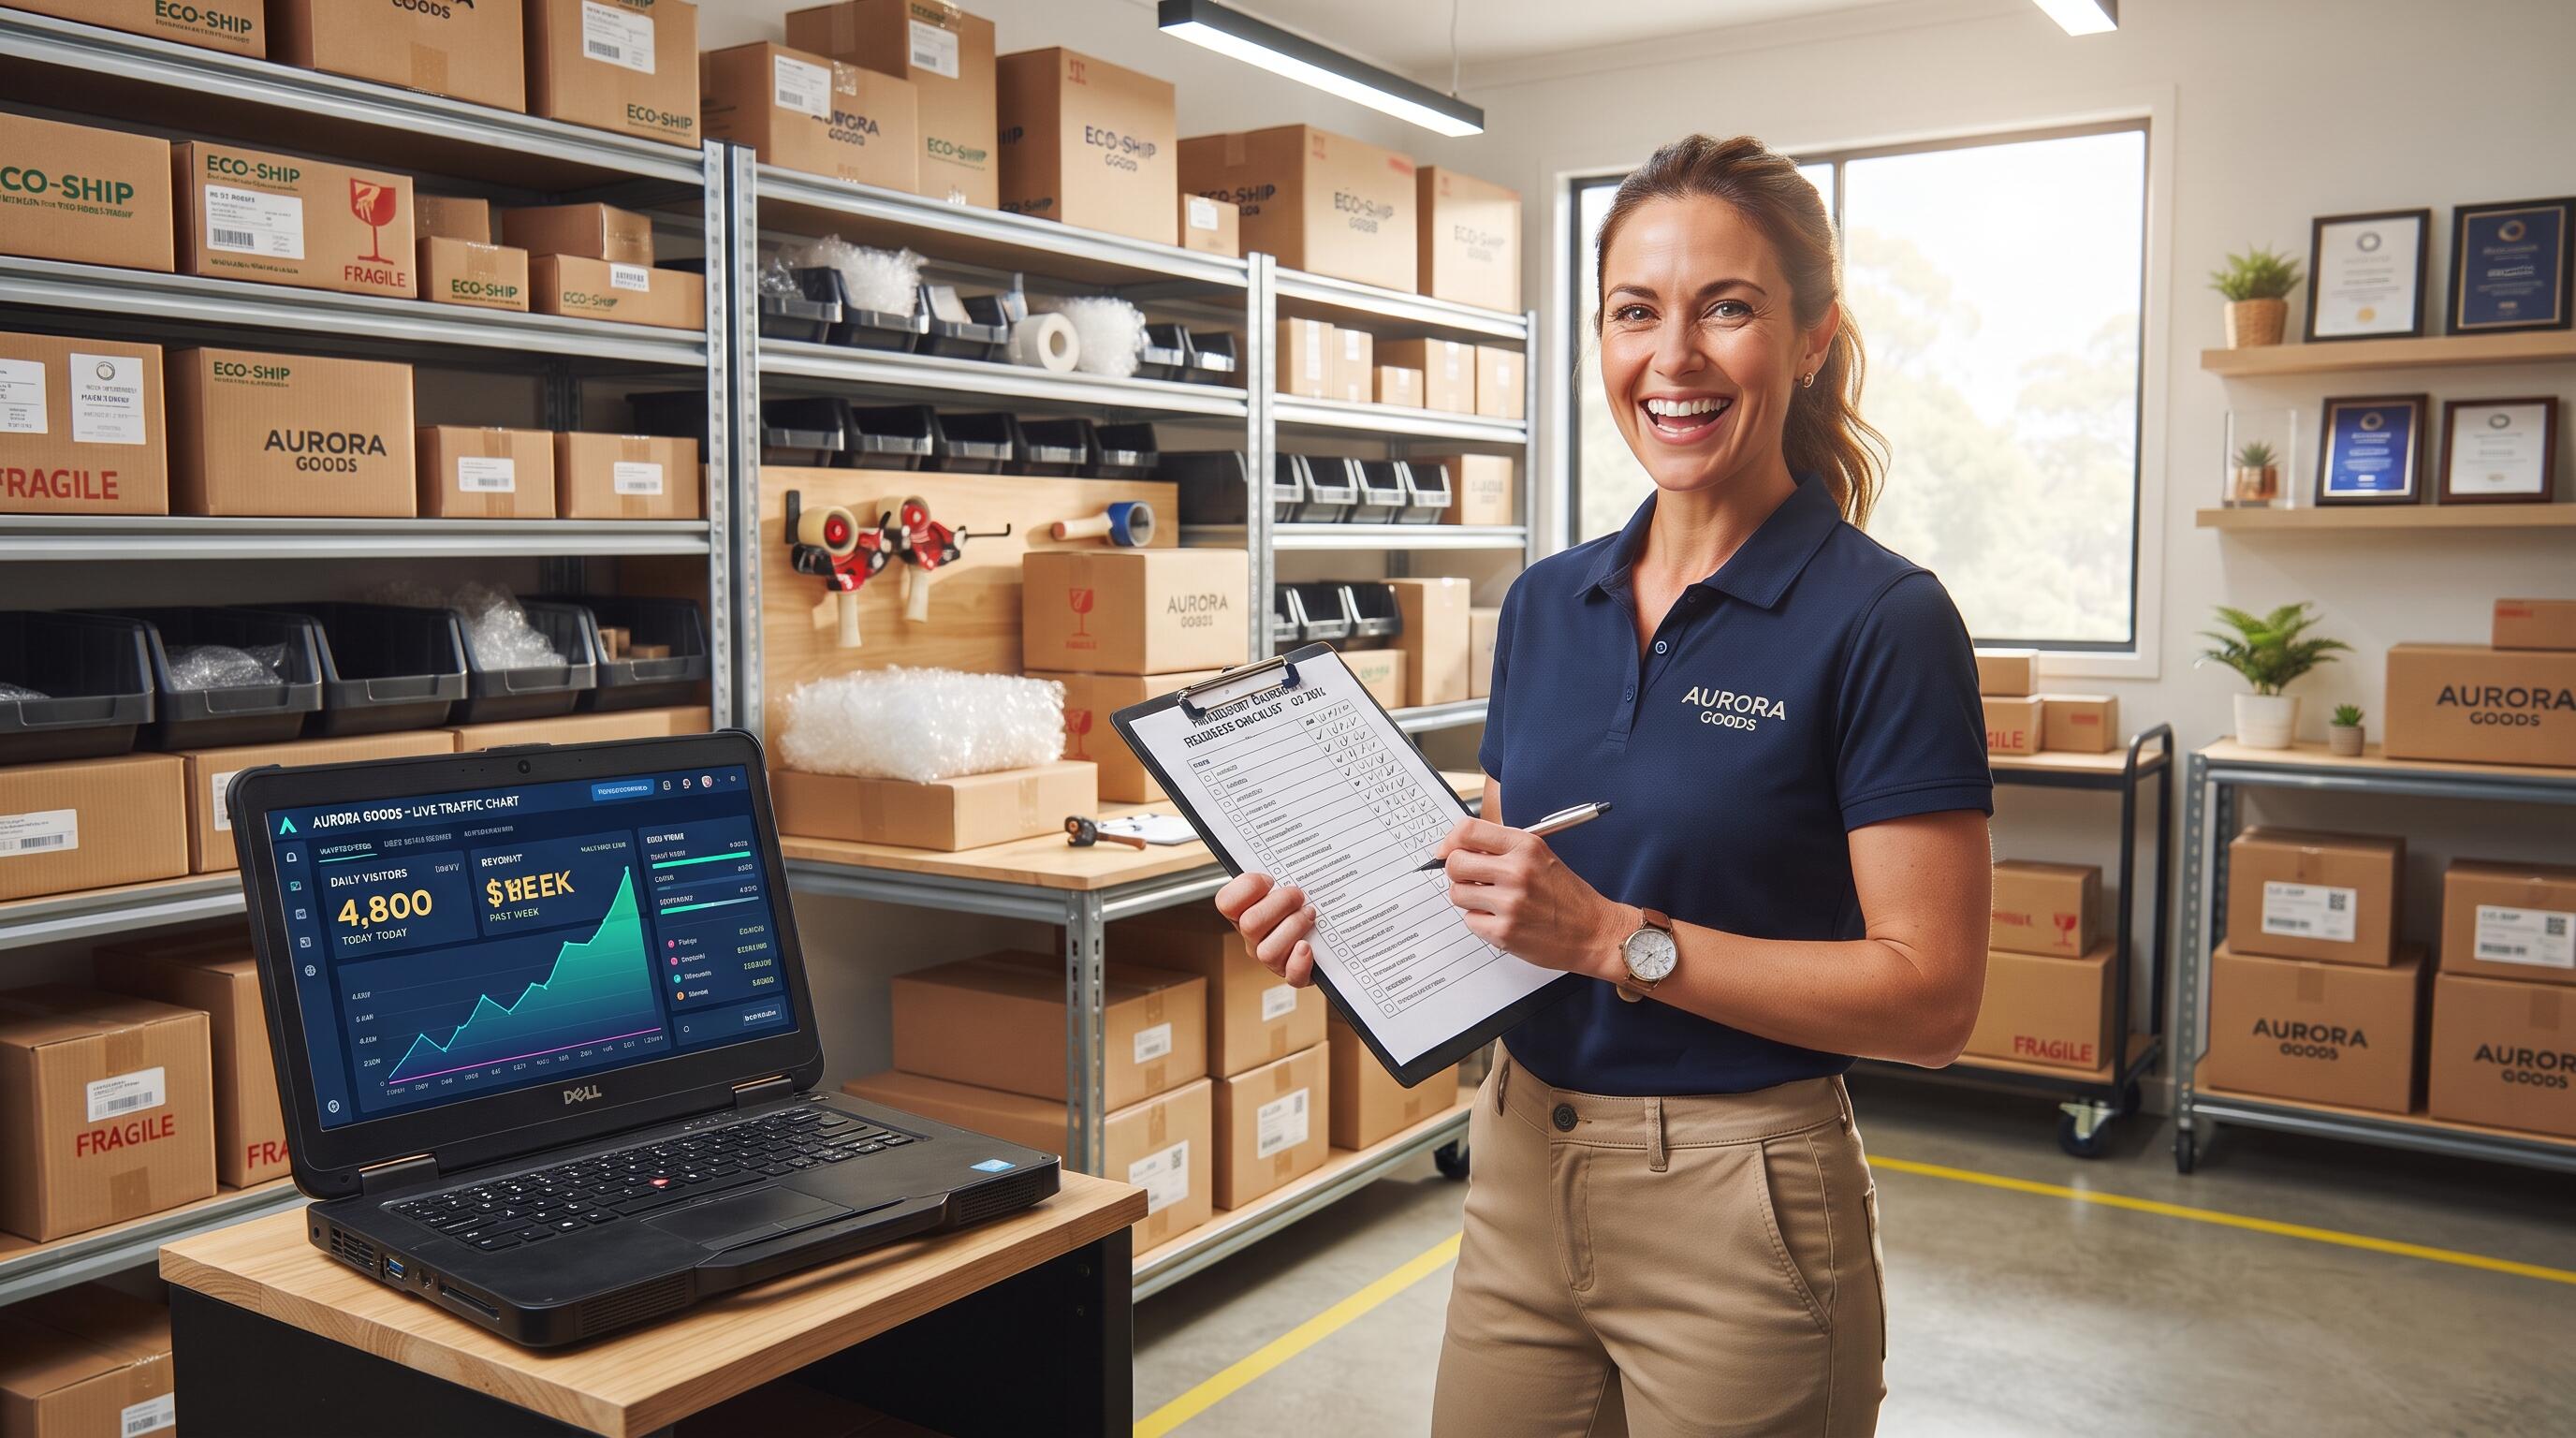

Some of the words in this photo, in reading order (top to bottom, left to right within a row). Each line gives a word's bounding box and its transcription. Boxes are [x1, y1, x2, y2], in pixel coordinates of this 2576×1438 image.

[155, 0, 252, 34] ECO-SHIP
[628, 103, 693, 129] ECO-SHIP
[207, 154, 300, 183] ECO-SHIP
[0, 167, 134, 205] CO-SHIP
[344, 265, 406, 287] FRAGILE
[451, 279, 518, 298] ECO-SHIP
[213, 361, 290, 381] ECO-SHIP
[264, 430, 388, 457] AURORA
[296, 456, 358, 473] GOODS
[0, 468, 119, 500] RAGILE
[1167, 594, 1228, 614] AURORA
[1681, 686, 1785, 720] AURORA
[2437, 684, 2576, 712] AURORA
[1701, 711, 1757, 730] GOODS
[2469, 712, 2540, 726] GOODS
[313, 811, 360, 829] AURORA
[363, 808, 402, 823] GOODS
[413, 804, 438, 817] LIVE
[438, 800, 483, 814] TRAFFIC
[485, 796, 519, 809] CHART
[330, 873, 360, 888] DAILY
[362, 869, 408, 883] VISITORS
[337, 888, 432, 929] 4,800
[490, 911, 511, 922] PAST
[514, 907, 540, 918] WEEK
[342, 932, 373, 946] TODAY
[376, 928, 407, 940] TODAY
[2252, 1018, 2368, 1049] AURORA
[2013, 1035, 2092, 1063] FRAGILE
[2474, 1044, 2576, 1073] AUROR
[564, 1085, 602, 1105] DELL
[77, 1114, 175, 1157] FRAGILE
[247, 1141, 289, 1168] FRA
